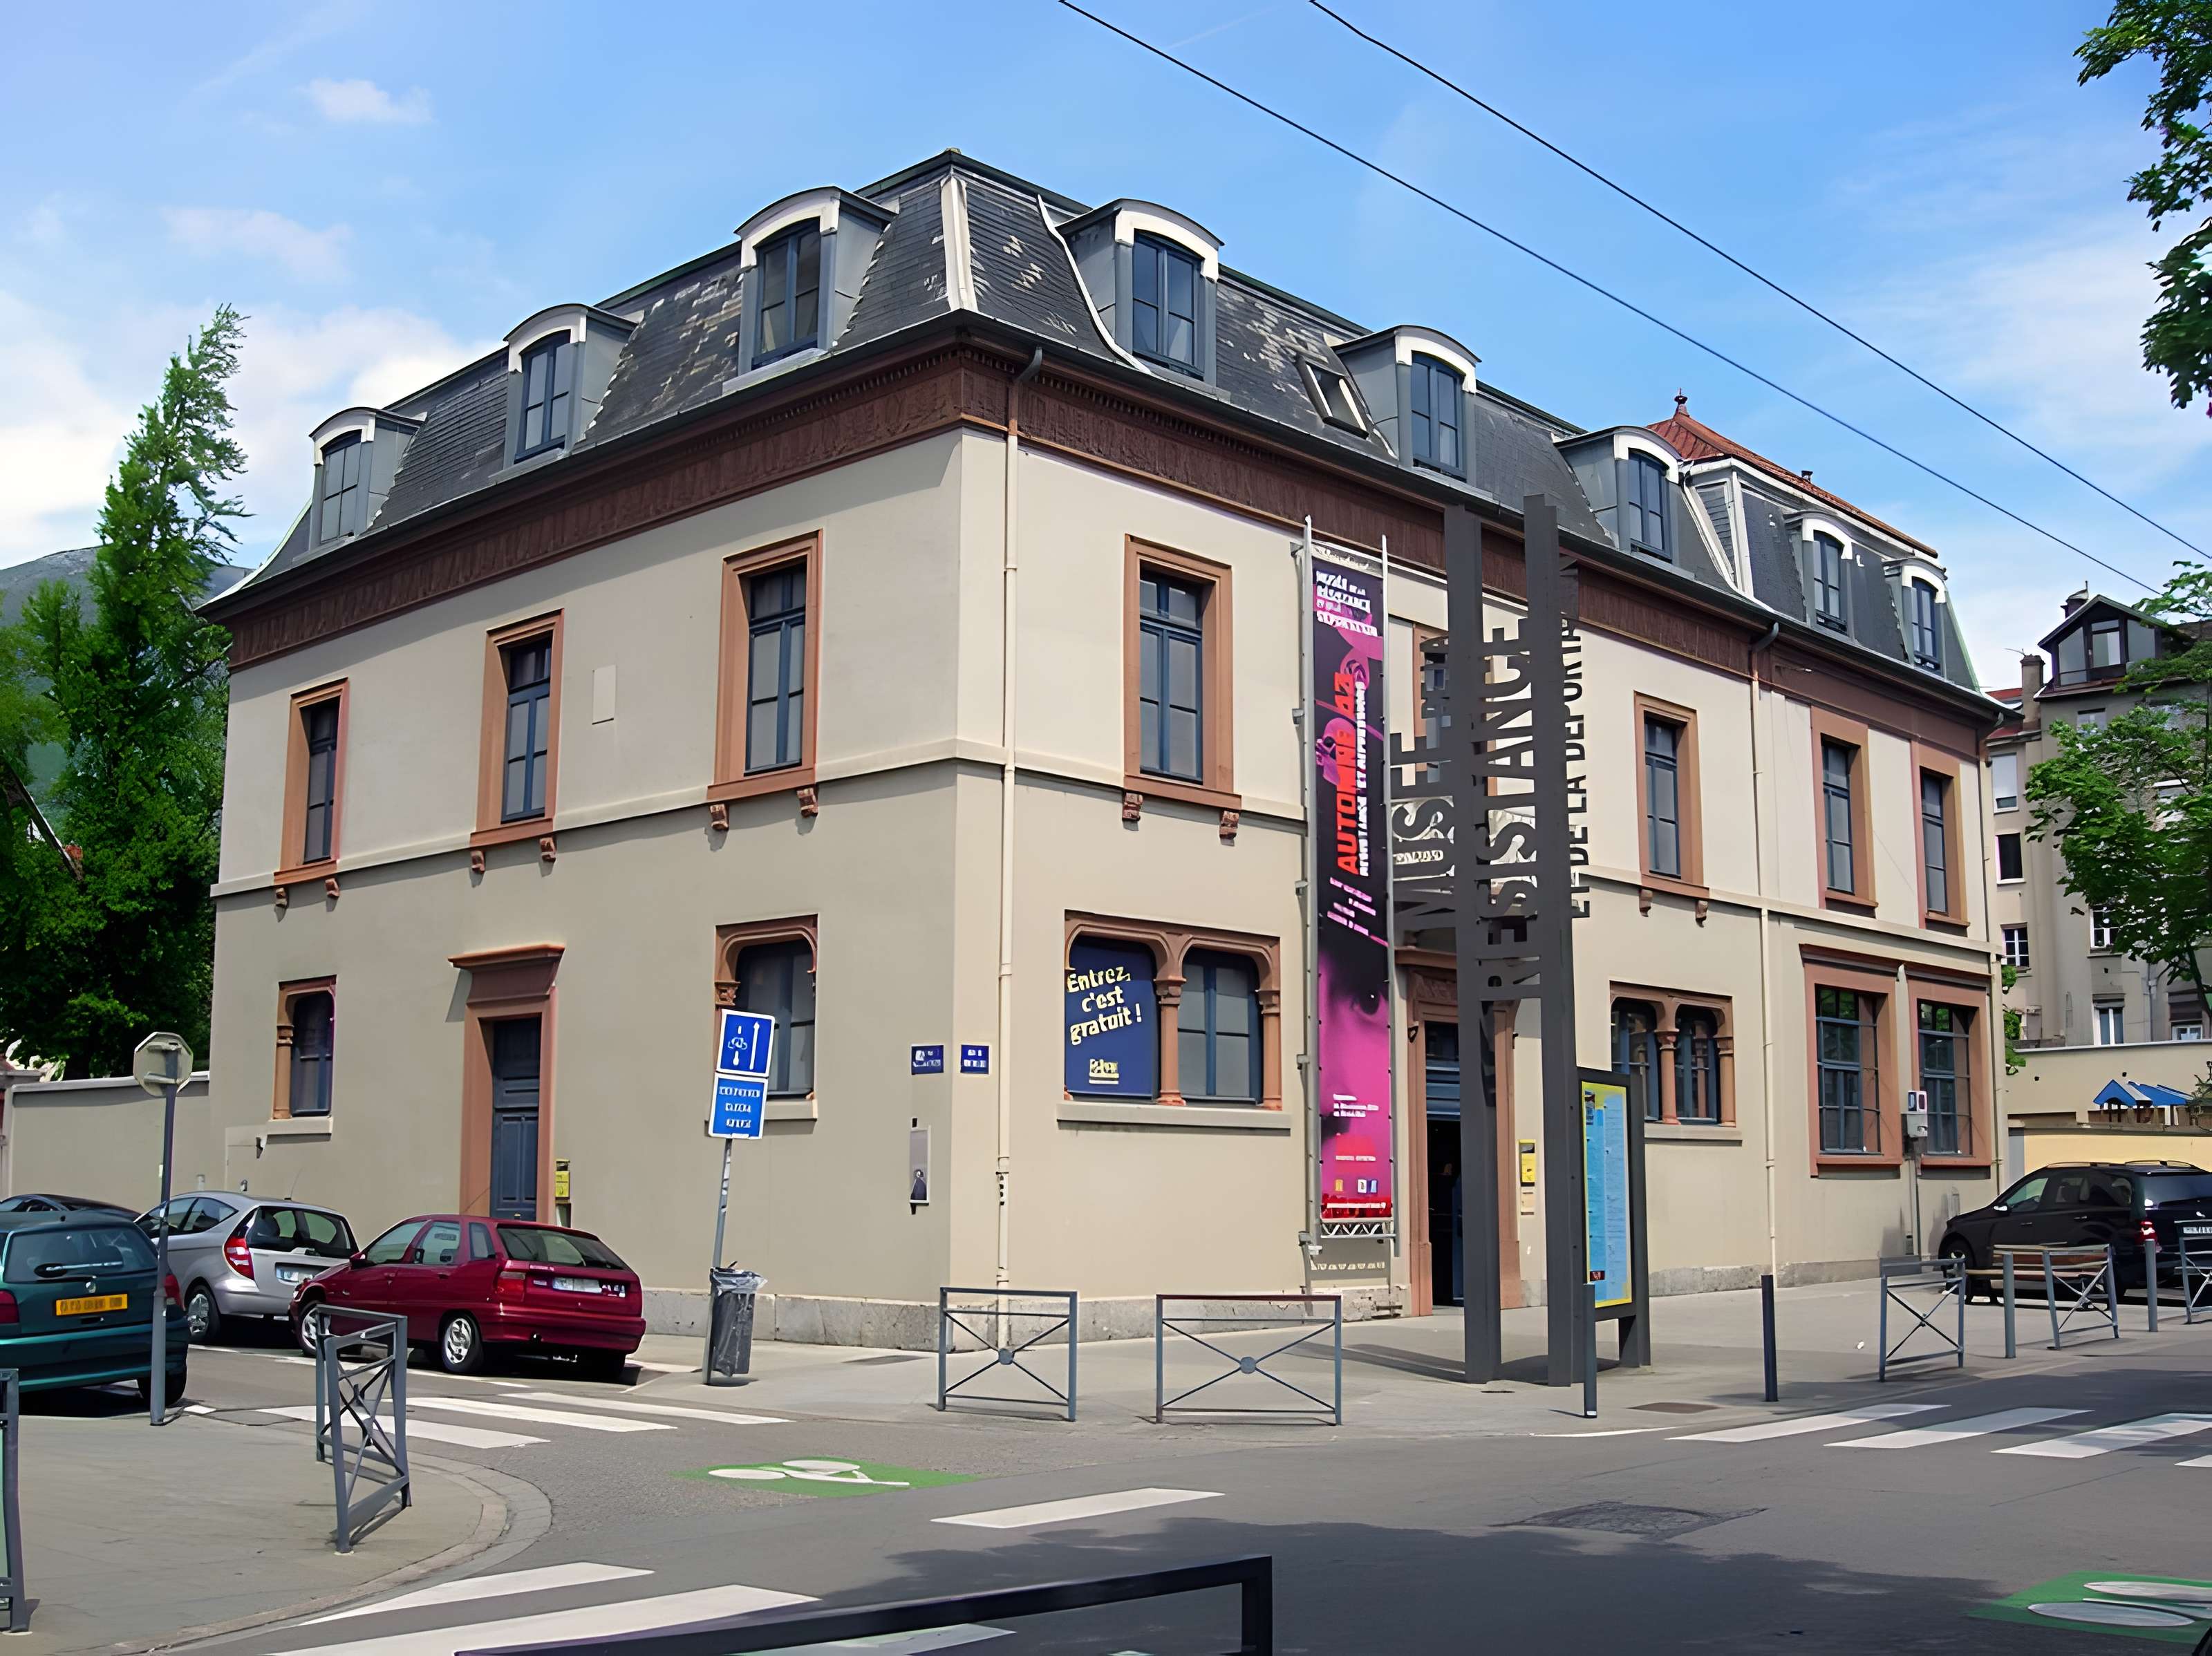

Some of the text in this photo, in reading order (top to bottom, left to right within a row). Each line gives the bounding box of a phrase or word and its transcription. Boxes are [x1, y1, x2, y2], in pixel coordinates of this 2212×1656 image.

[1067, 966, 1131, 992] Entrez,
[1082, 986, 1125, 1013] c'est
[1070, 1007, 1132, 1046] gratuit
